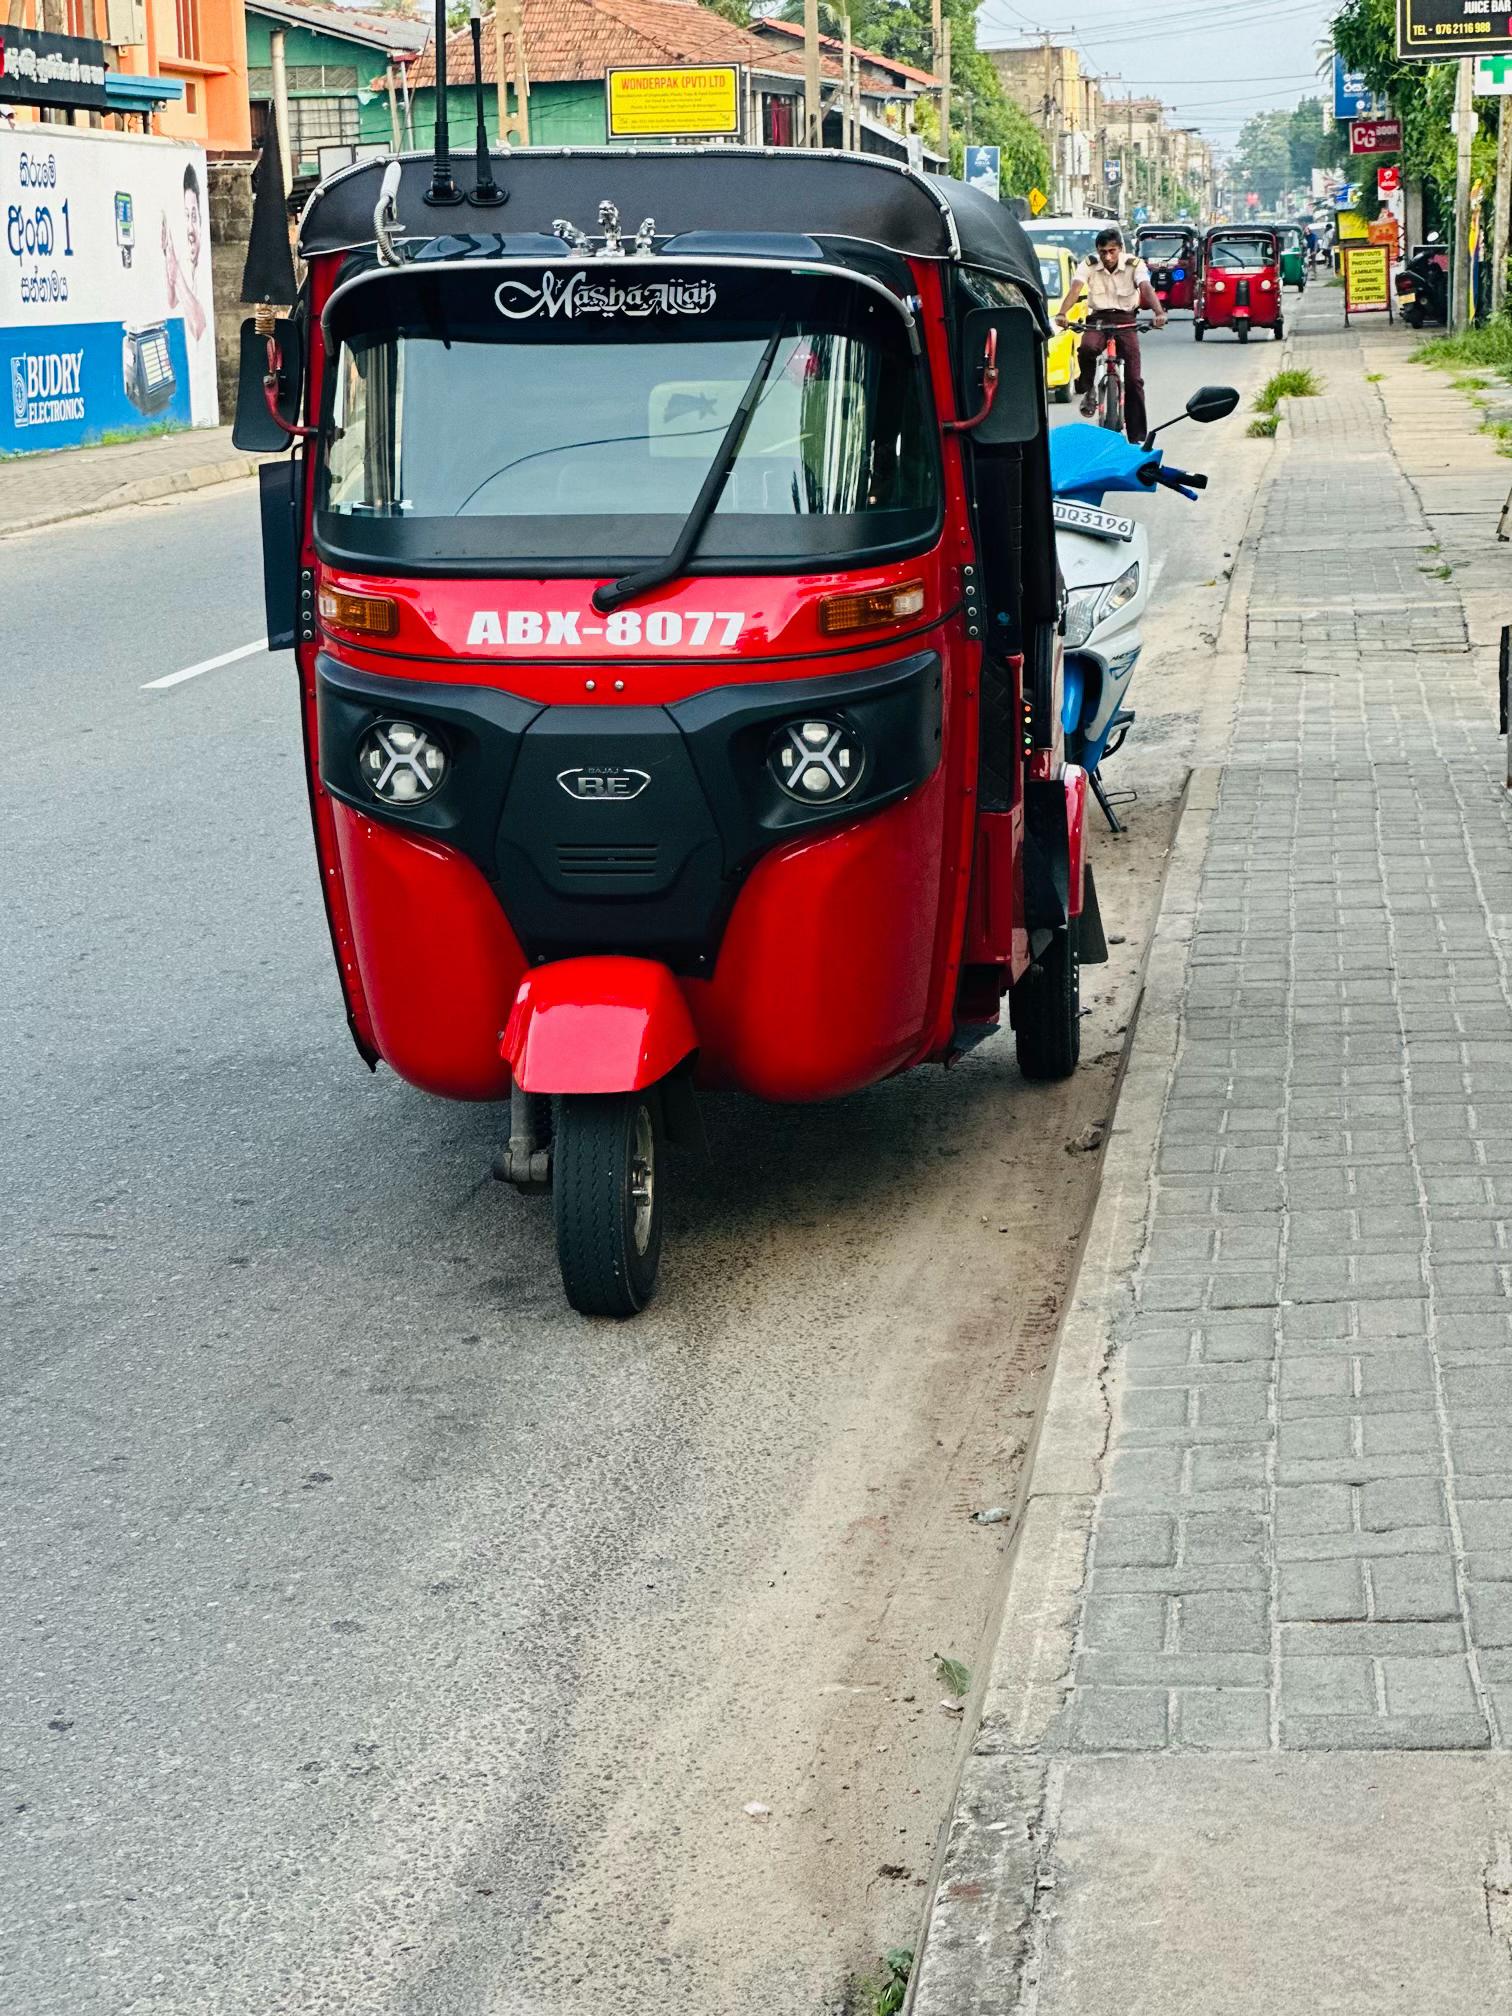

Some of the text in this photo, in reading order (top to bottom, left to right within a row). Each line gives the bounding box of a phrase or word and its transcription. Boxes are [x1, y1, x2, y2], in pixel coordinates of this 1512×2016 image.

[1463, 0, 1512, 14] JUICE BAR
[1435, 23, 1452, 35] 076
[1453, 23, 1474, 34] 2116
[621, 75, 726, 91] WONDERPAK (PVT) LTD
[1353, 127, 1376, 148] CG
[61, 197, 74, 257] 1
[27, 348, 84, 398] BUDRY
[29, 397, 85, 425] ELECTRONICS
[466, 610, 746, 647] ABX-8077
[577, 777, 630, 795] RE
